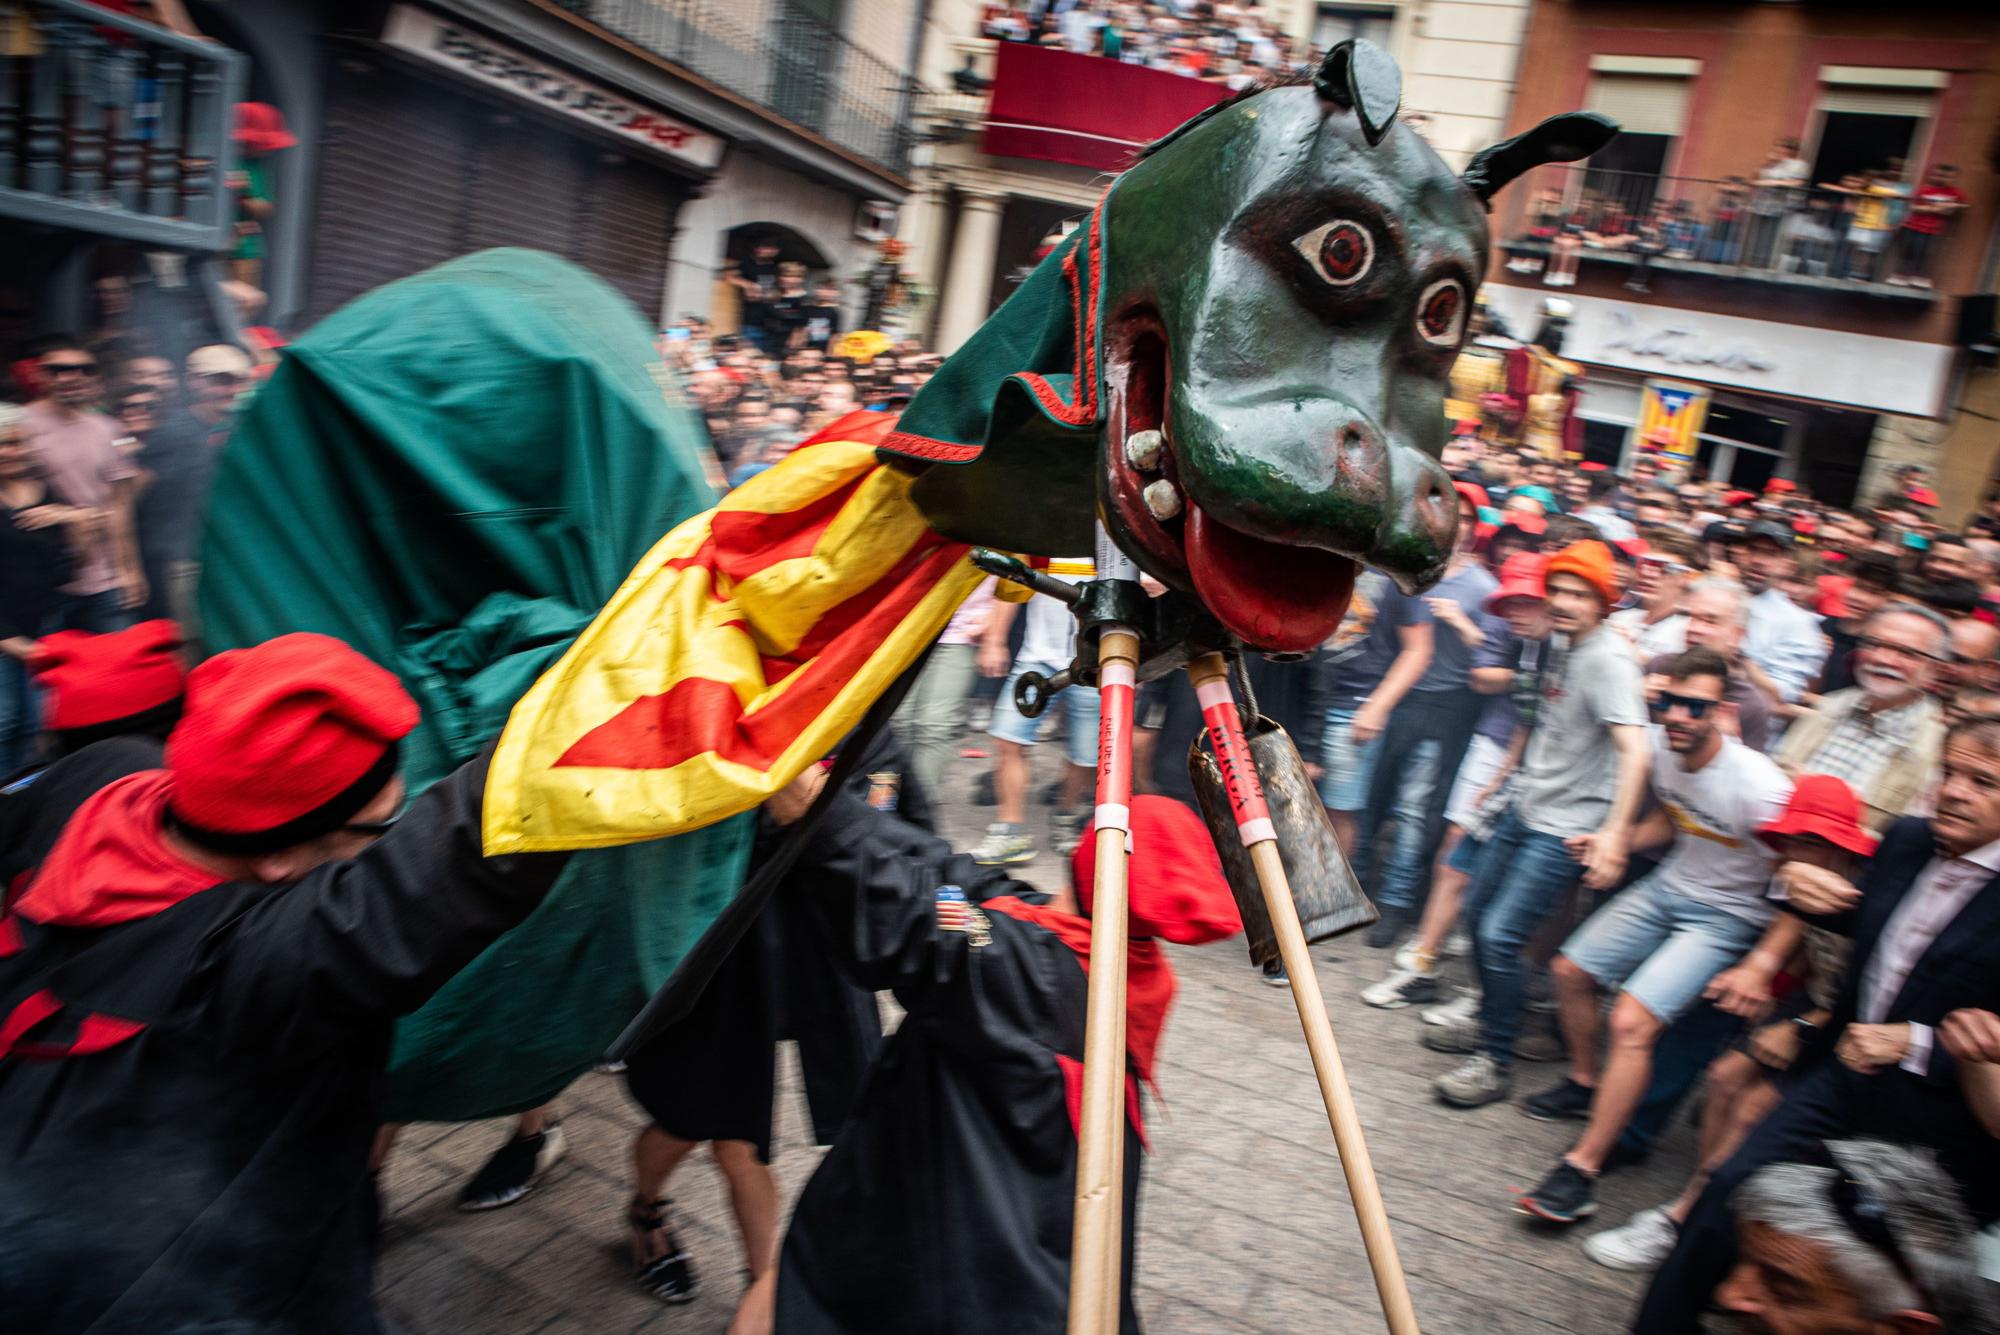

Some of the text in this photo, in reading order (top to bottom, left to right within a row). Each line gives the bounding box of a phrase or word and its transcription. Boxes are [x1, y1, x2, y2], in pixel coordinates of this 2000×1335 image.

[1103, 745, 1113, 760] DE
[1103, 762, 1113, 776] LA
[1213, 725, 1249, 811] BERGA
